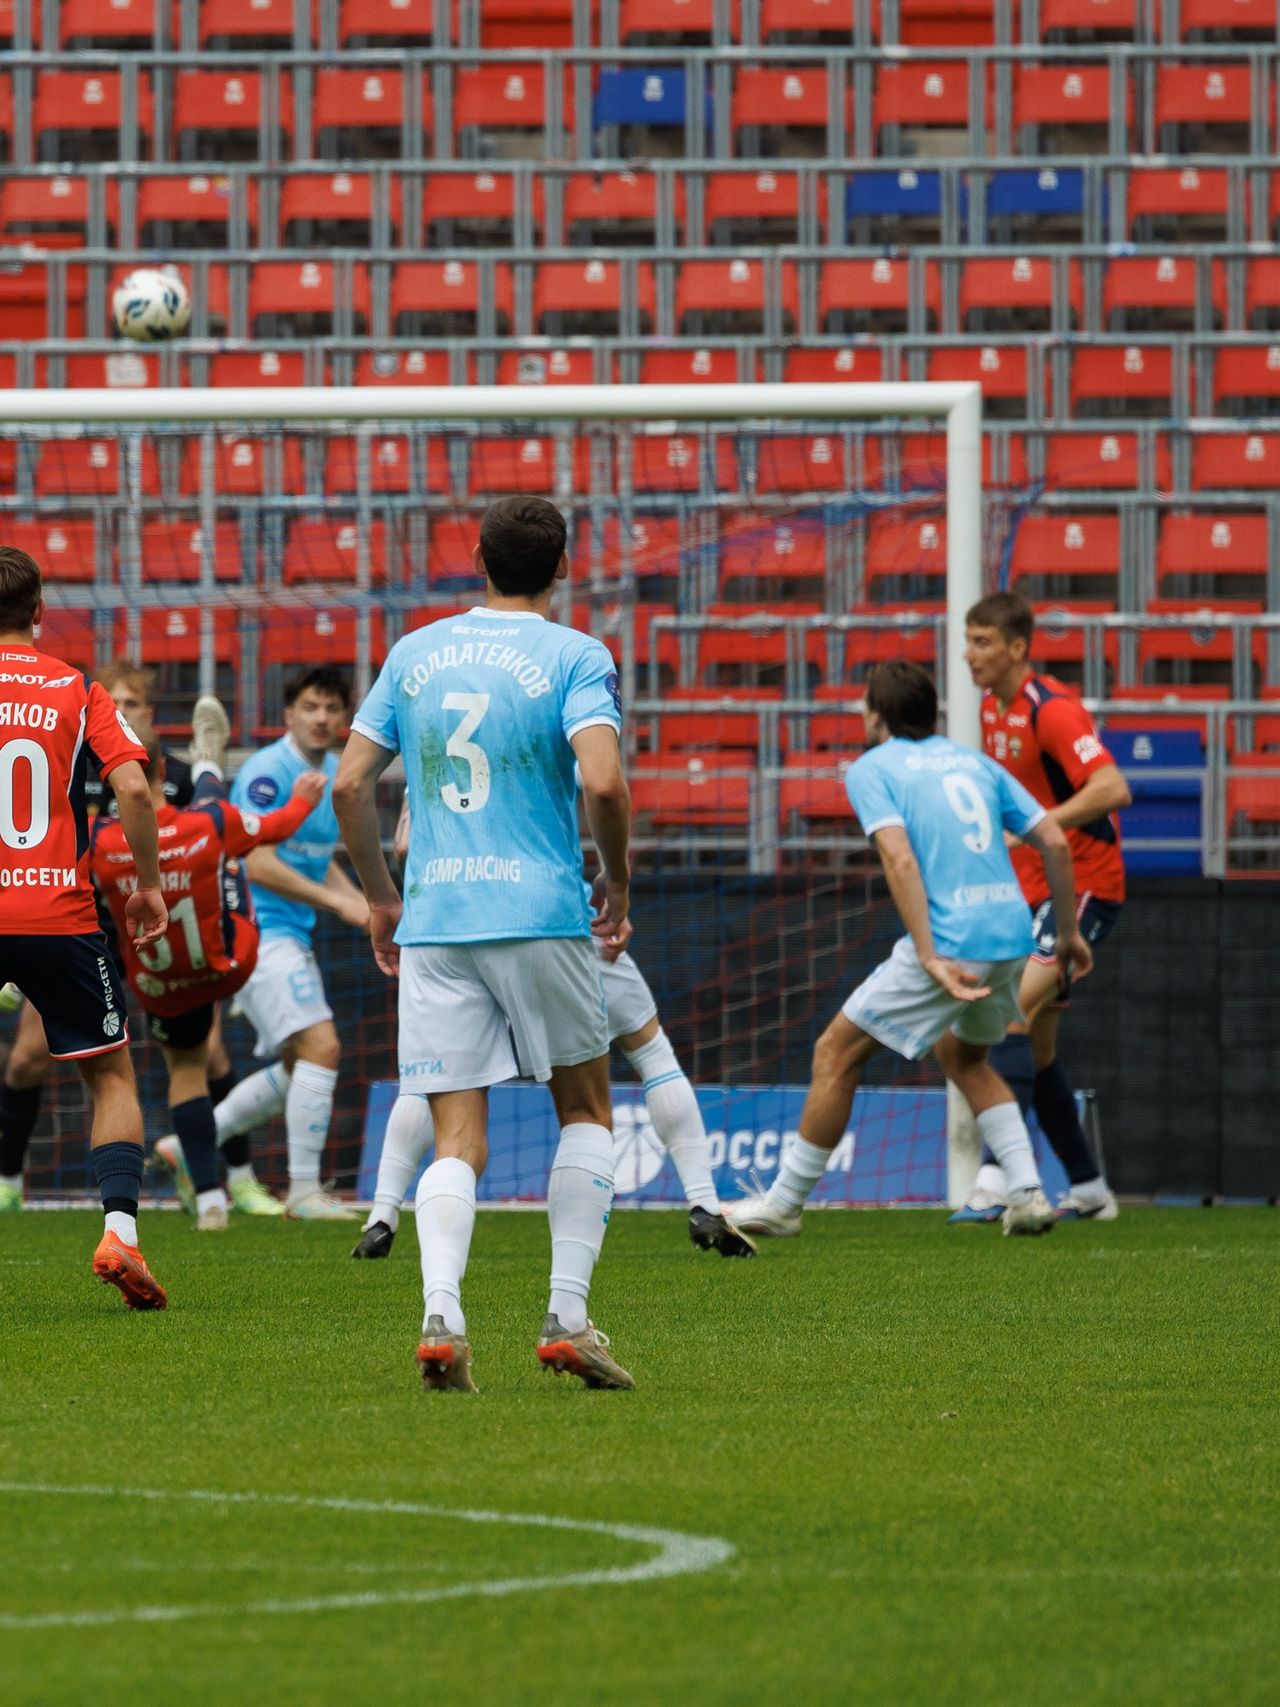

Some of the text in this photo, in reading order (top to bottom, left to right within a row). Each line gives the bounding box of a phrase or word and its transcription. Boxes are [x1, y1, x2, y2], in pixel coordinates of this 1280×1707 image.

[451, 625, 521, 637] БЕТСИТИ
[402, 642, 552, 699] СОЛДАТЕНКОВ
[440, 692, 491, 814] 3
[942, 772, 992, 854] 9
[431, 855, 521, 884] SMP RACING
[96, 956, 114, 1010] РОССЕТИ
